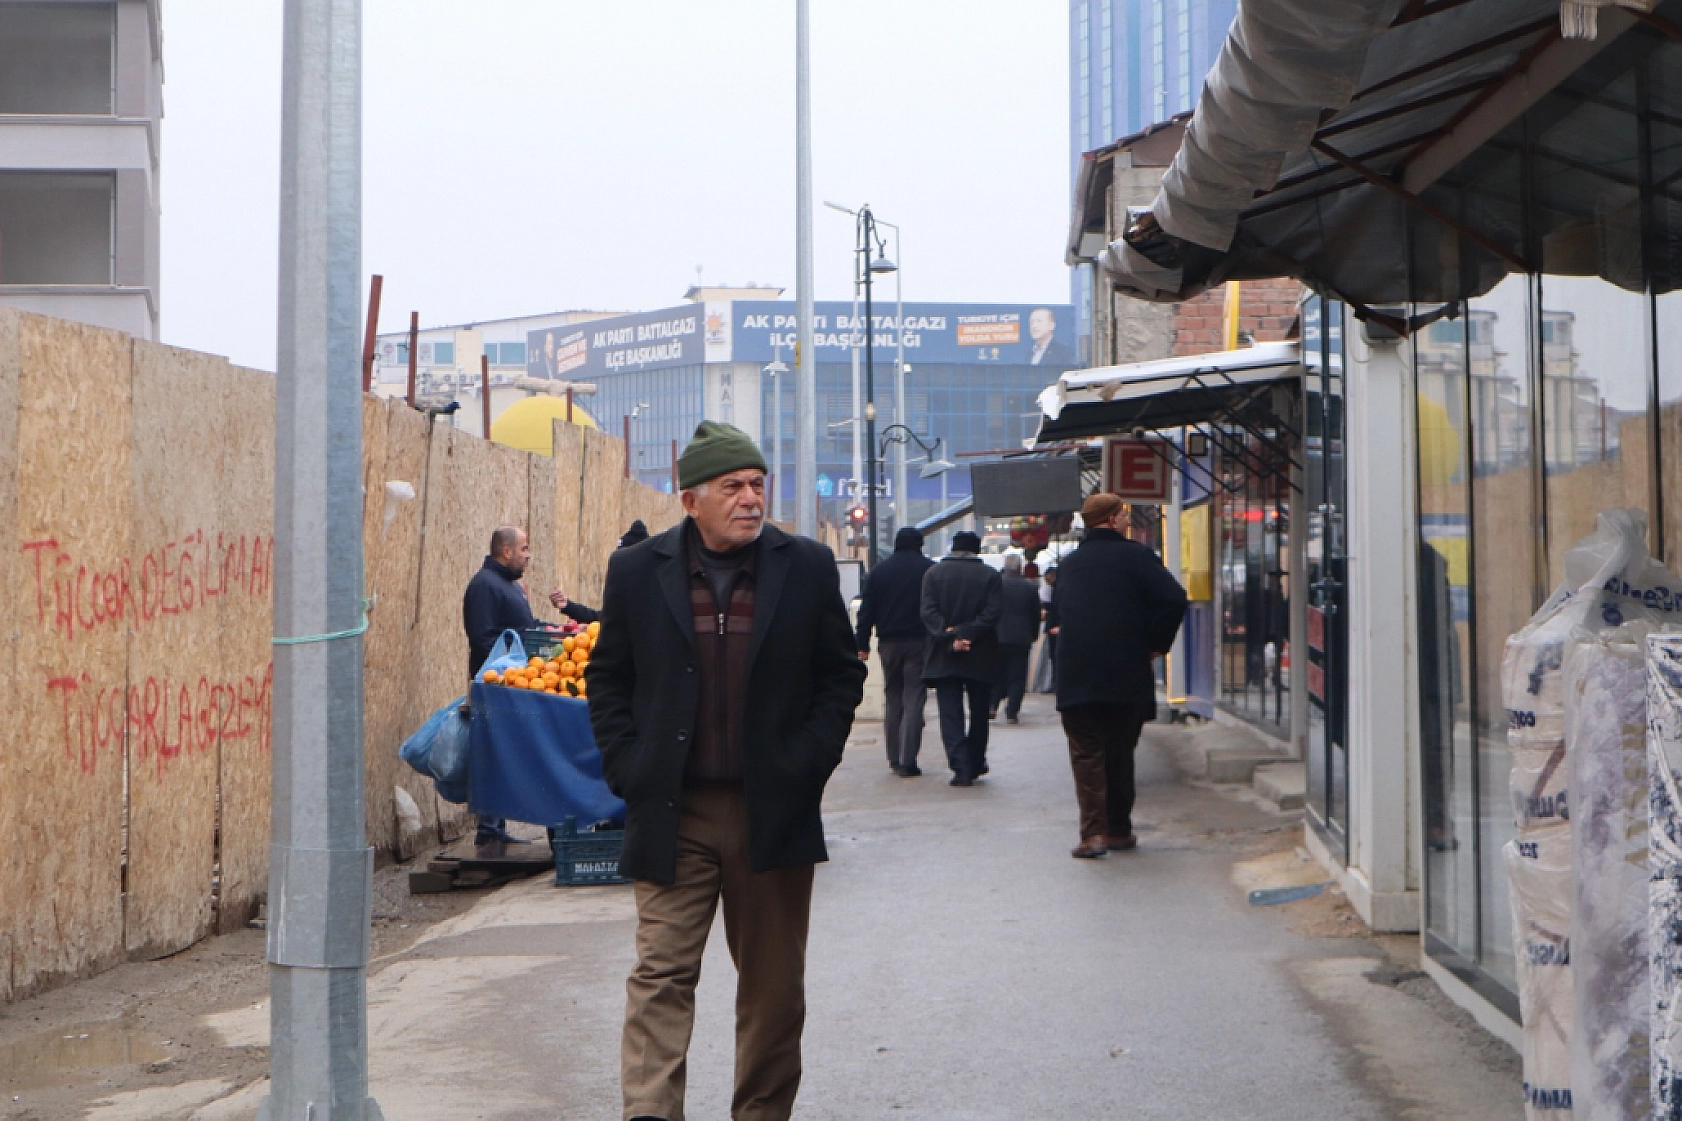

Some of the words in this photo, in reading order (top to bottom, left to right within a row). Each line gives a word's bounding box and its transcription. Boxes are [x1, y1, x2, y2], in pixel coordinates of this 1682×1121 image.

[742, 314, 769, 328] AK
[773, 314, 827, 329] PATİ
[593, 330, 607, 348] AK
[769, 333, 798, 350] İLÇ
[1122, 448, 1156, 491] E
